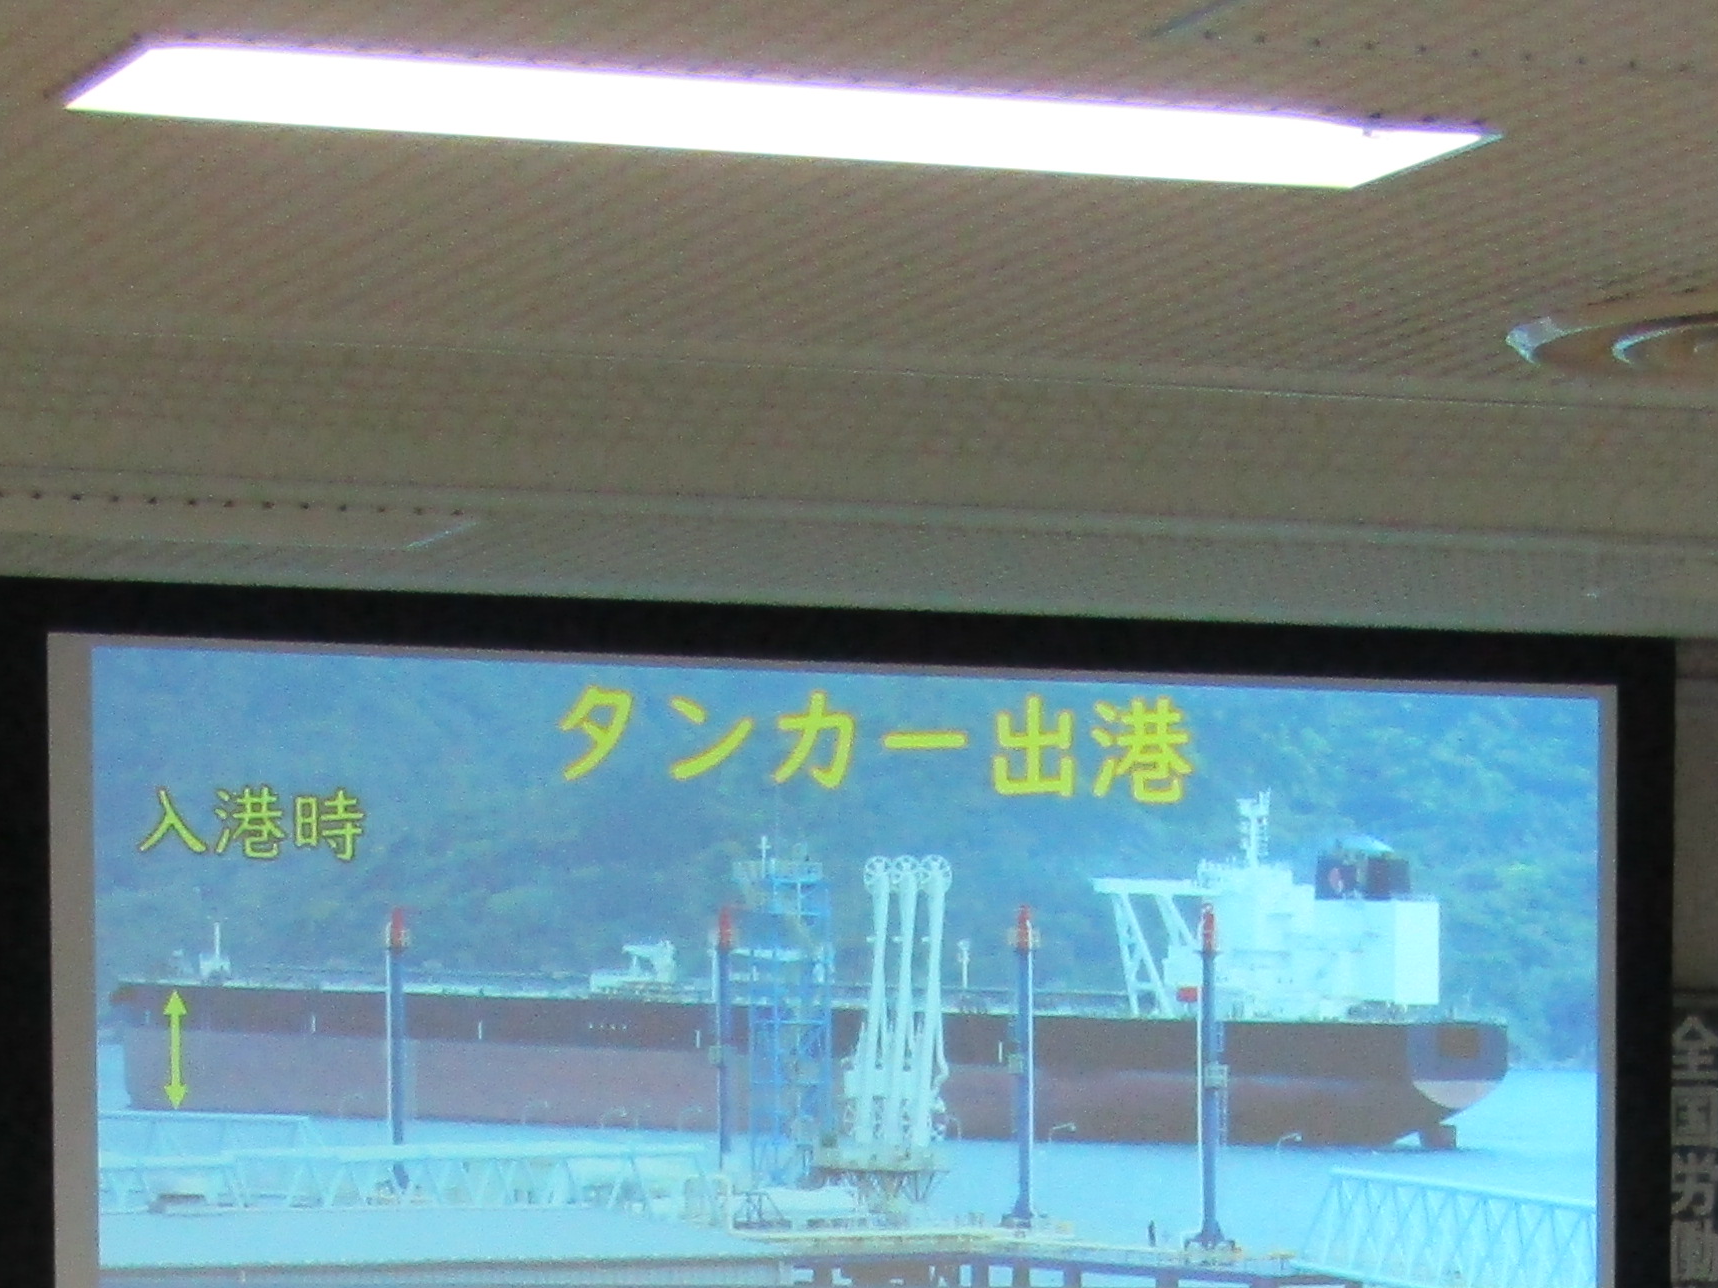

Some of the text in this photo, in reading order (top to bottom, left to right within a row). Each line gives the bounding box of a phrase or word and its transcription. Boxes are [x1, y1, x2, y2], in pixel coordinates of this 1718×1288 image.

[559, 684, 1194, 803] タンカー出港
[137, 784, 366, 861] 入港時
